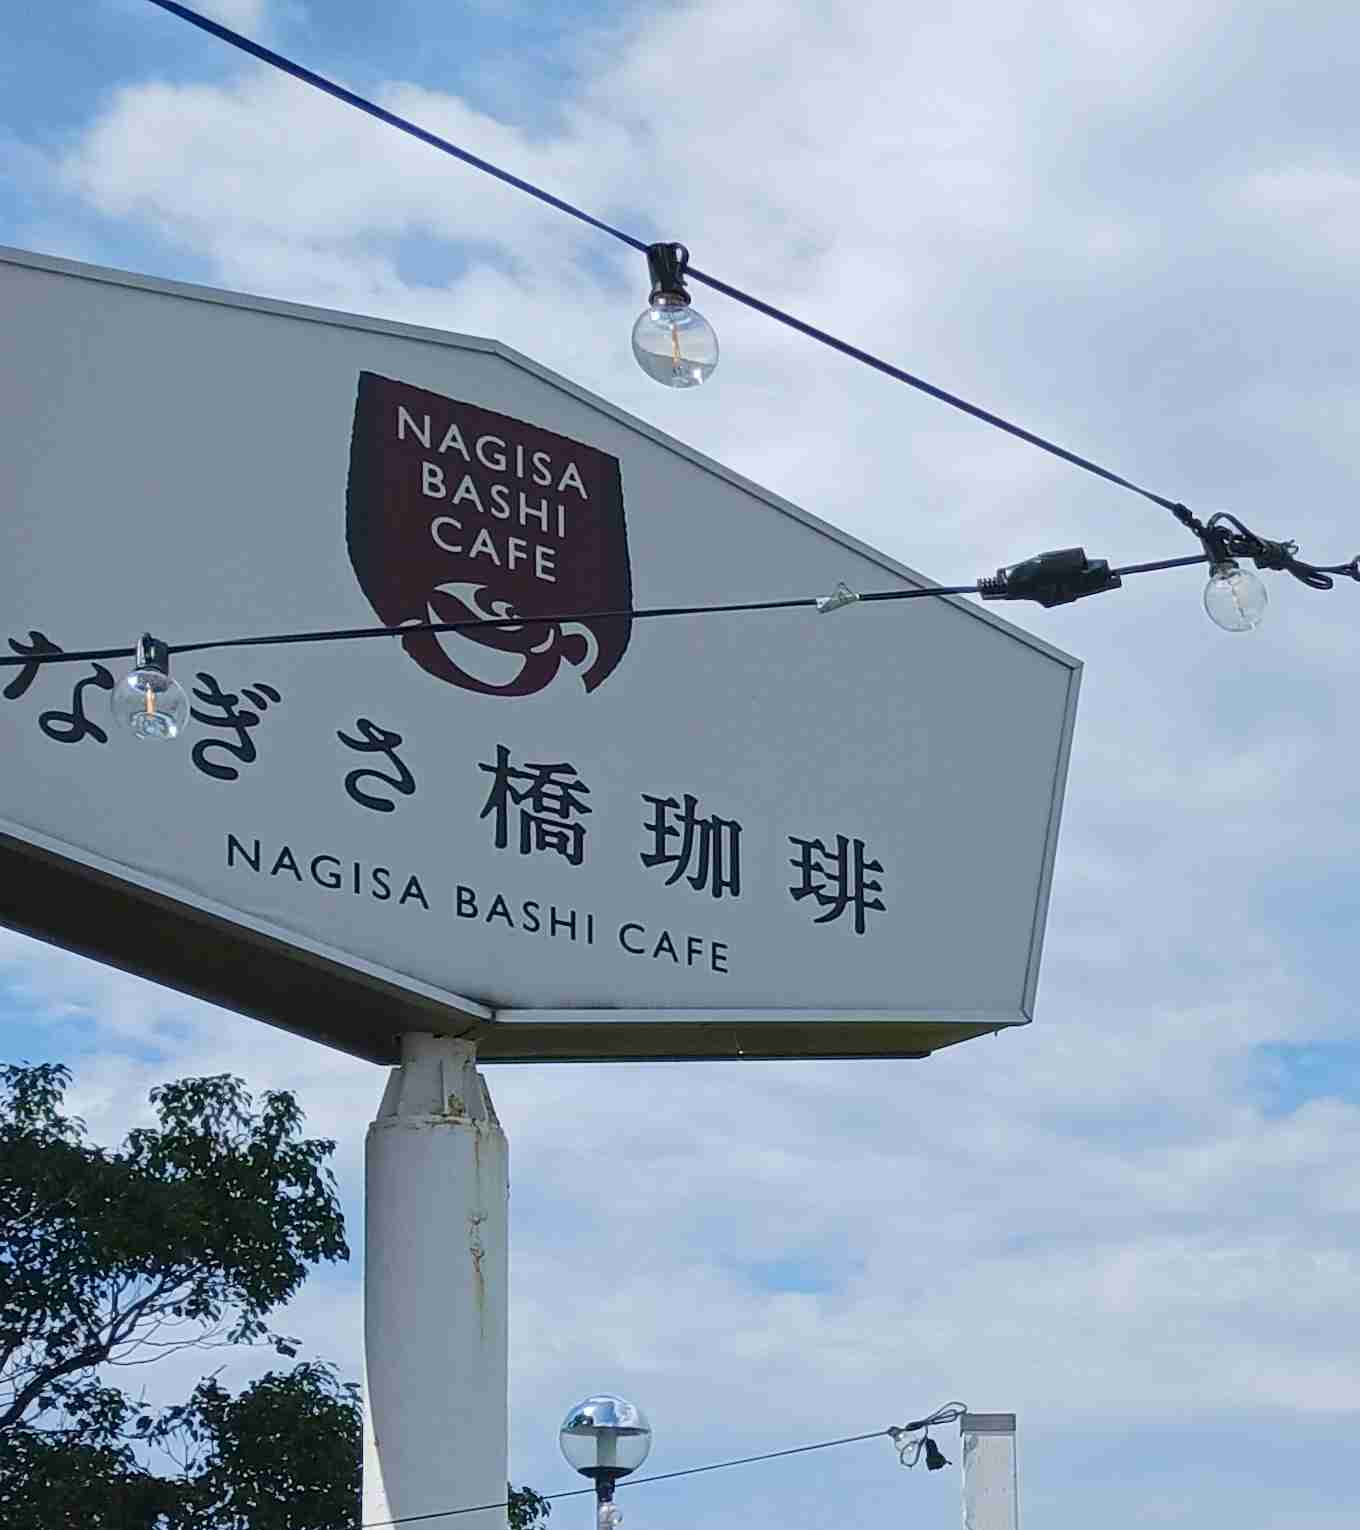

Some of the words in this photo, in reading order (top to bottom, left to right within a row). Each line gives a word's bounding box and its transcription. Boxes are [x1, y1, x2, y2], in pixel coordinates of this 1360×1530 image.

[397, 405, 588, 500] NAGISA
[422, 461, 567, 539] BASHI
[430, 515, 557, 582] CAFE
[3, 630, 888, 936] なぎさ橋珈琲
[227, 832, 430, 910] NAGISA
[456, 885, 594, 946] BASHI
[618, 922, 729, 974] CAFE
